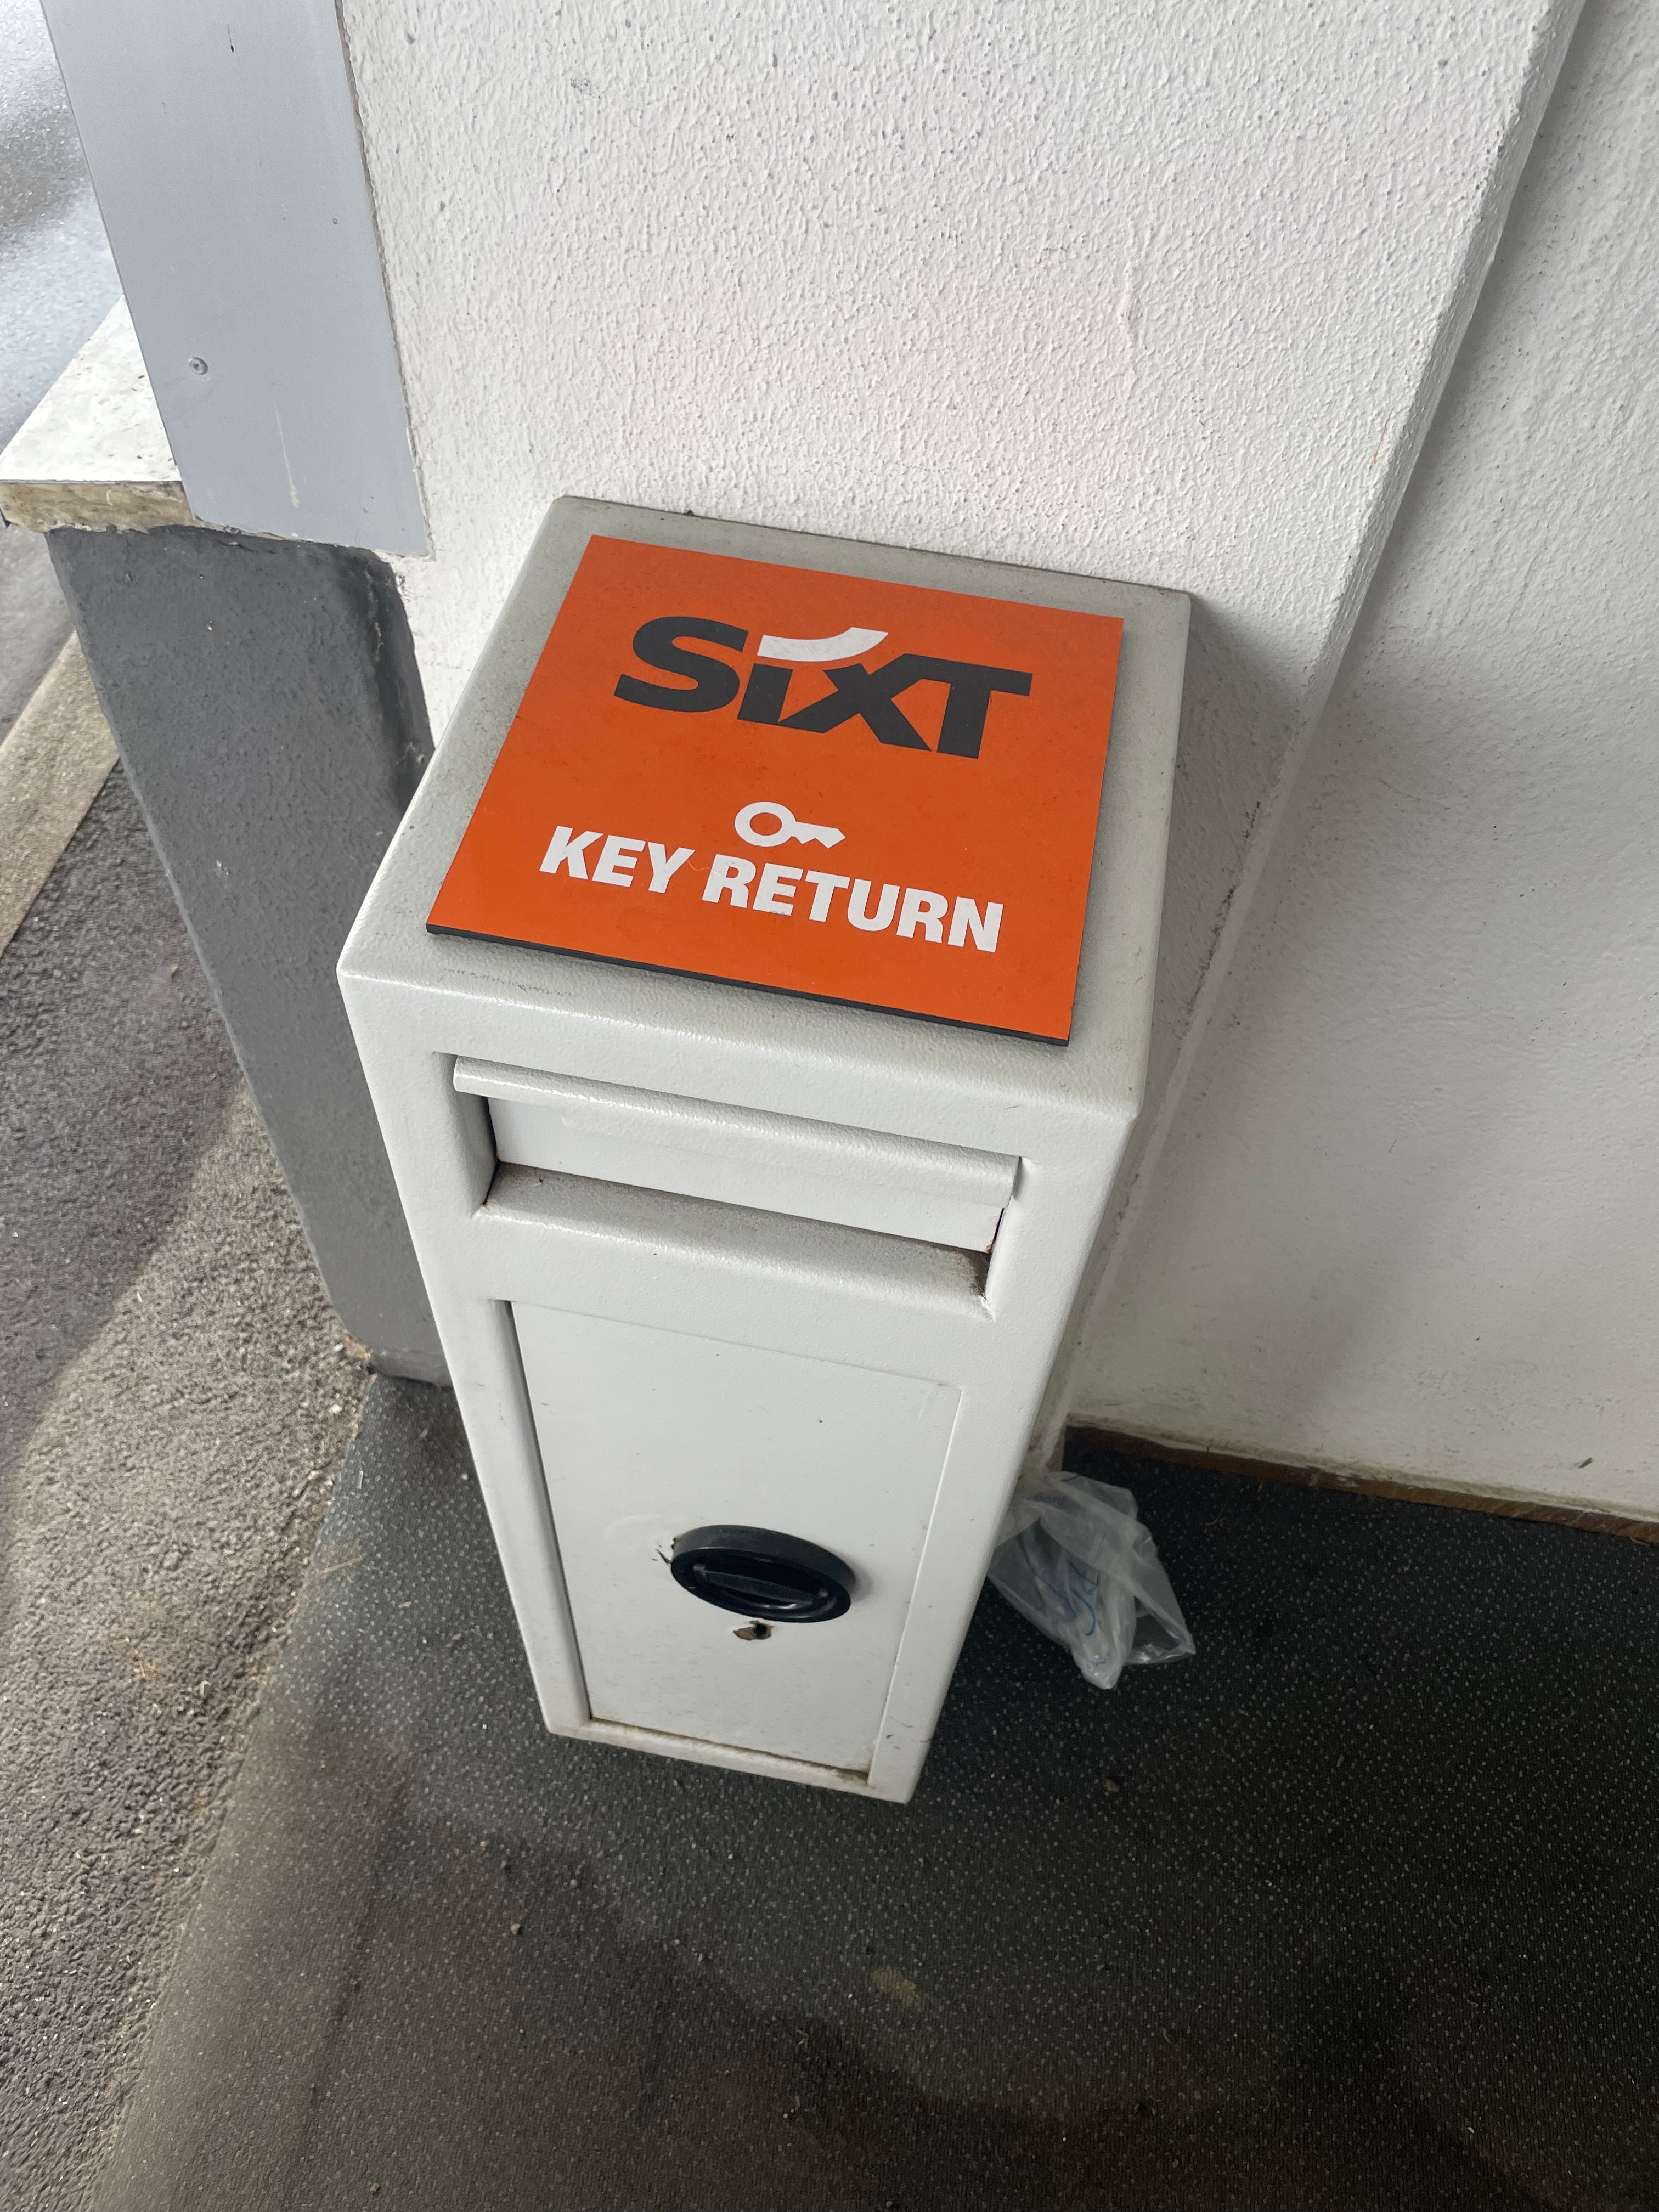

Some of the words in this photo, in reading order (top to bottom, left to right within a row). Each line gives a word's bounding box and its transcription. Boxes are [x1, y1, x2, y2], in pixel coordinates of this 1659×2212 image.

[614, 617, 1032, 759] SIXT
[539, 826, 695, 893] KEY
[702, 854, 1003, 952] RETURN
